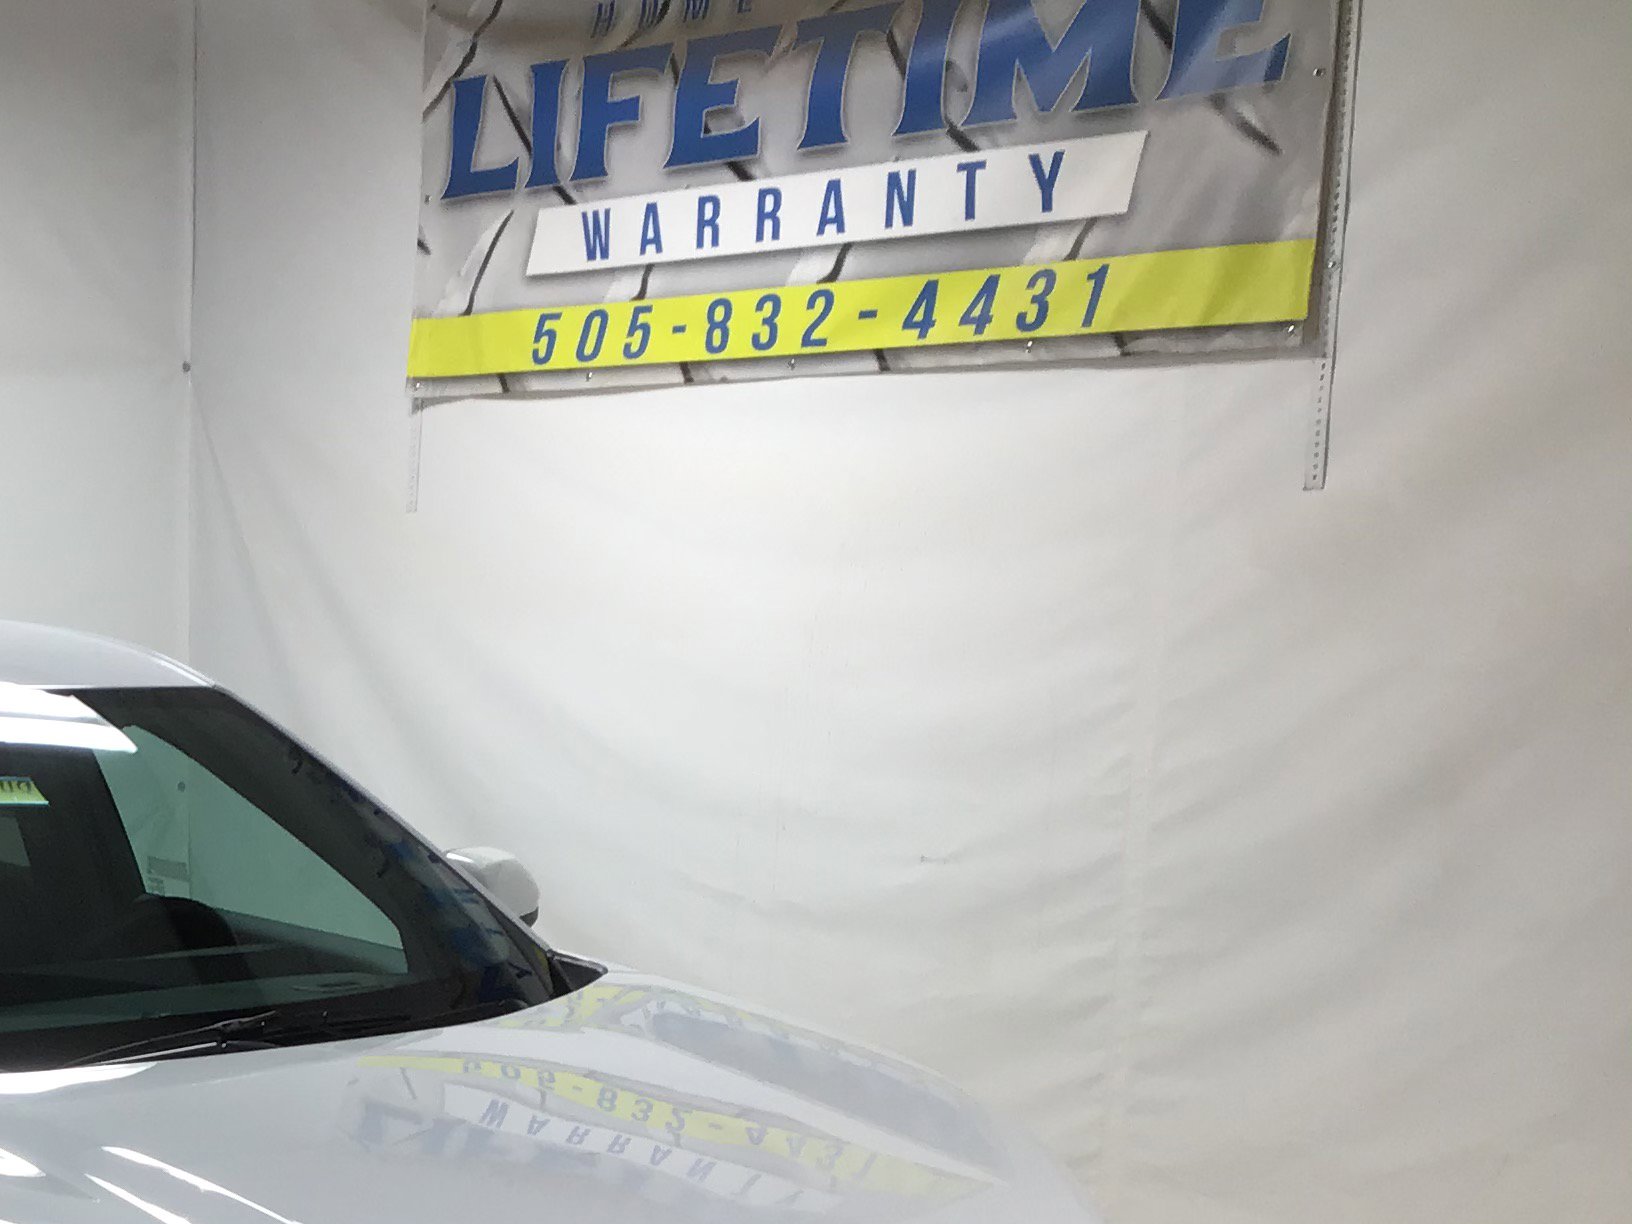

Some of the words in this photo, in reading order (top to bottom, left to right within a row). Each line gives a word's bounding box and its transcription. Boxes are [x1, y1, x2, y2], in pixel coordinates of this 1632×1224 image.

[441, 0, 1292, 201] LIFETIME
[581, 150, 1067, 262] WARRANTY
[532, 264, 1111, 367] 505-832-4431
